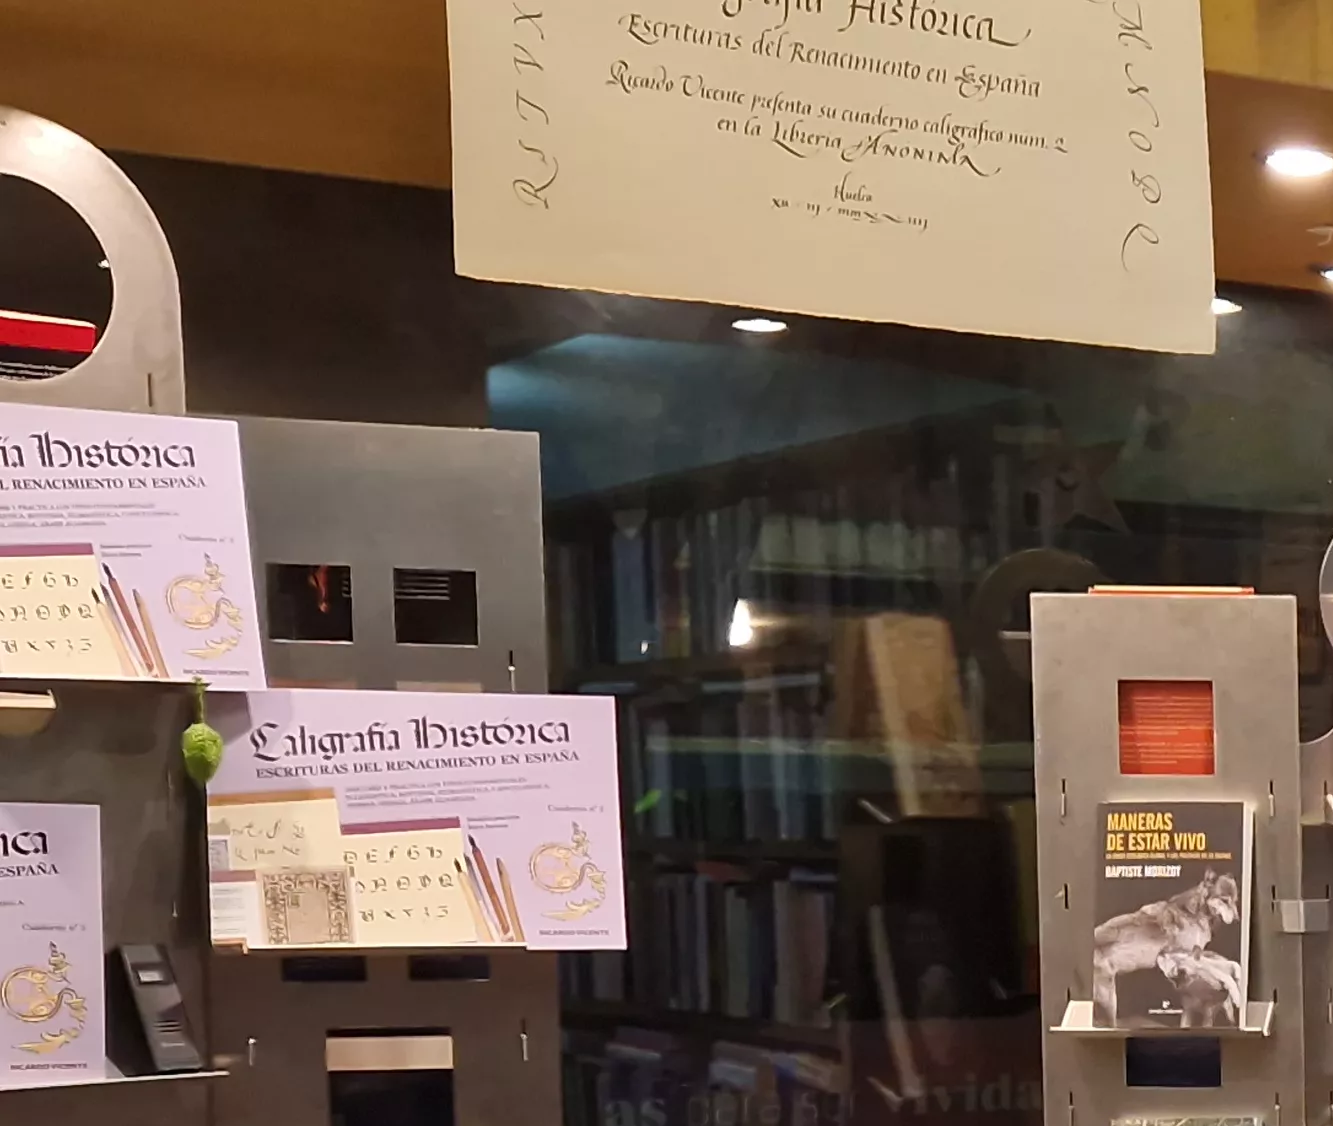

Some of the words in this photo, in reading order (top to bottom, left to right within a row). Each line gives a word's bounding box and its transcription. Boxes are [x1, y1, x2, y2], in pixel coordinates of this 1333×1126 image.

[617, 13, 743, 50] Escrituras
[752, 29, 790, 59] del
[789, 40, 922, 80] Renacimiento
[926, 65, 948, 84] en
[954, 64, 1041, 101] España
[605, 60, 674, 94] Ricardo
[680, 74, 746, 105] Vicente
[817, 106, 837, 120] su
[841, 103, 920, 131] cuaderno
[717, 117, 738, 134] en
[743, 116, 762, 138] la
[29, 431, 196, 469] Histórica
[12, 477, 125, 491] RENACIMIENTO
[128, 477, 147, 489] EN
[152, 475, 207, 489] ESPAÑA
[249, 721, 401, 762] Caligrafía
[407, 715, 571, 750] Histórica
[255, 763, 350, 780] ESCRITURAS
[353, 760, 383, 774] DEL
[386, 755, 497, 772] RENACIMIENTO
[500, 753, 520, 766] EN
[525, 749, 580, 764] ESPAÑA
[1106, 811, 1173, 832] MANERAS
[1106, 833, 1125, 851] DE
[1128, 832, 1170, 851] ESTAR
[1173, 832, 1206, 851] VIVO
[1105, 865, 1143, 878] BAPTISTE
